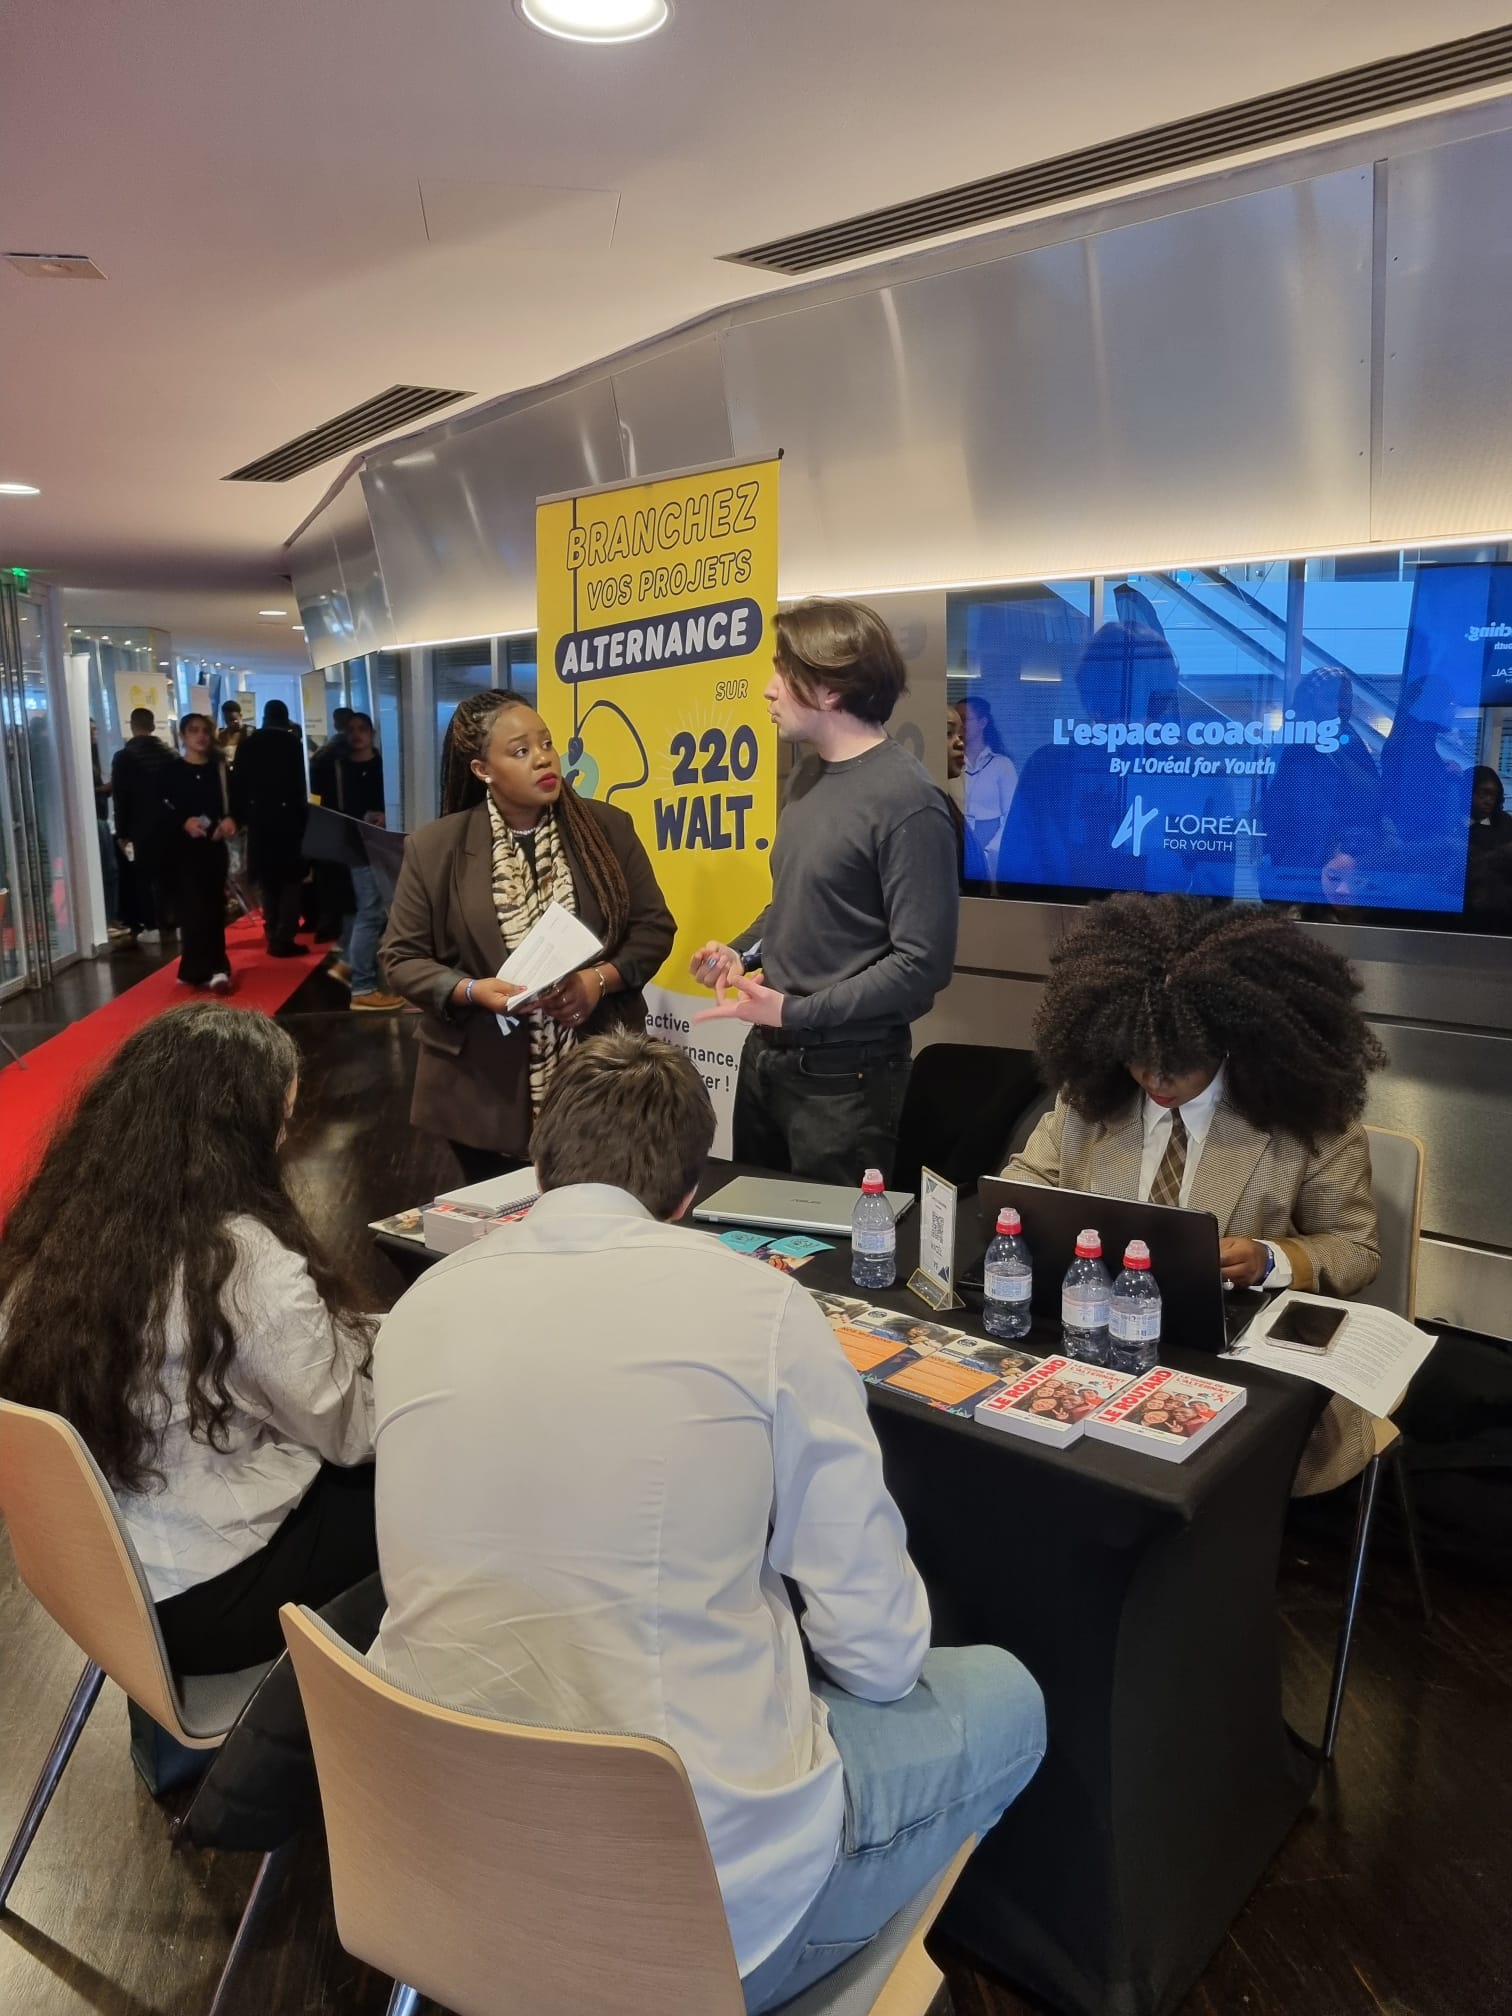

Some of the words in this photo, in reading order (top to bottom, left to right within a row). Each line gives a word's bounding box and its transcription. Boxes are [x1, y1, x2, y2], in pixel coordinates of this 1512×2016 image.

[567, 481, 759, 570] BRANCHEZ
[587, 574, 632, 611] VOS
[638, 549, 752, 601] PROJETS
[561, 607, 749, 676] ALTERNANCE
[716, 679, 748, 701] SUR
[670, 725, 758, 786] 220
[1053, 718, 1180, 752] L'espace
[1187, 709, 1349, 753] coaching.
[1109, 757, 1130, 777] By
[1133, 755, 1190, 775] L'Oréal
[1191, 757, 1219, 777] for
[1224, 758, 1275, 775] Youth
[654, 794, 769, 851] WALT.
[1163, 838, 1187, 850] FOR
[1190, 839, 1233, 851] YOUTH
[1165, 814, 1267, 836] L'ORÉAL
[988, 1397, 1012, 1410] LE
[1004, 1359, 1067, 1399] ROUTARD
[1098, 1409, 1123, 1423] LE
[1112, 1370, 1172, 1410] ROUTARD
